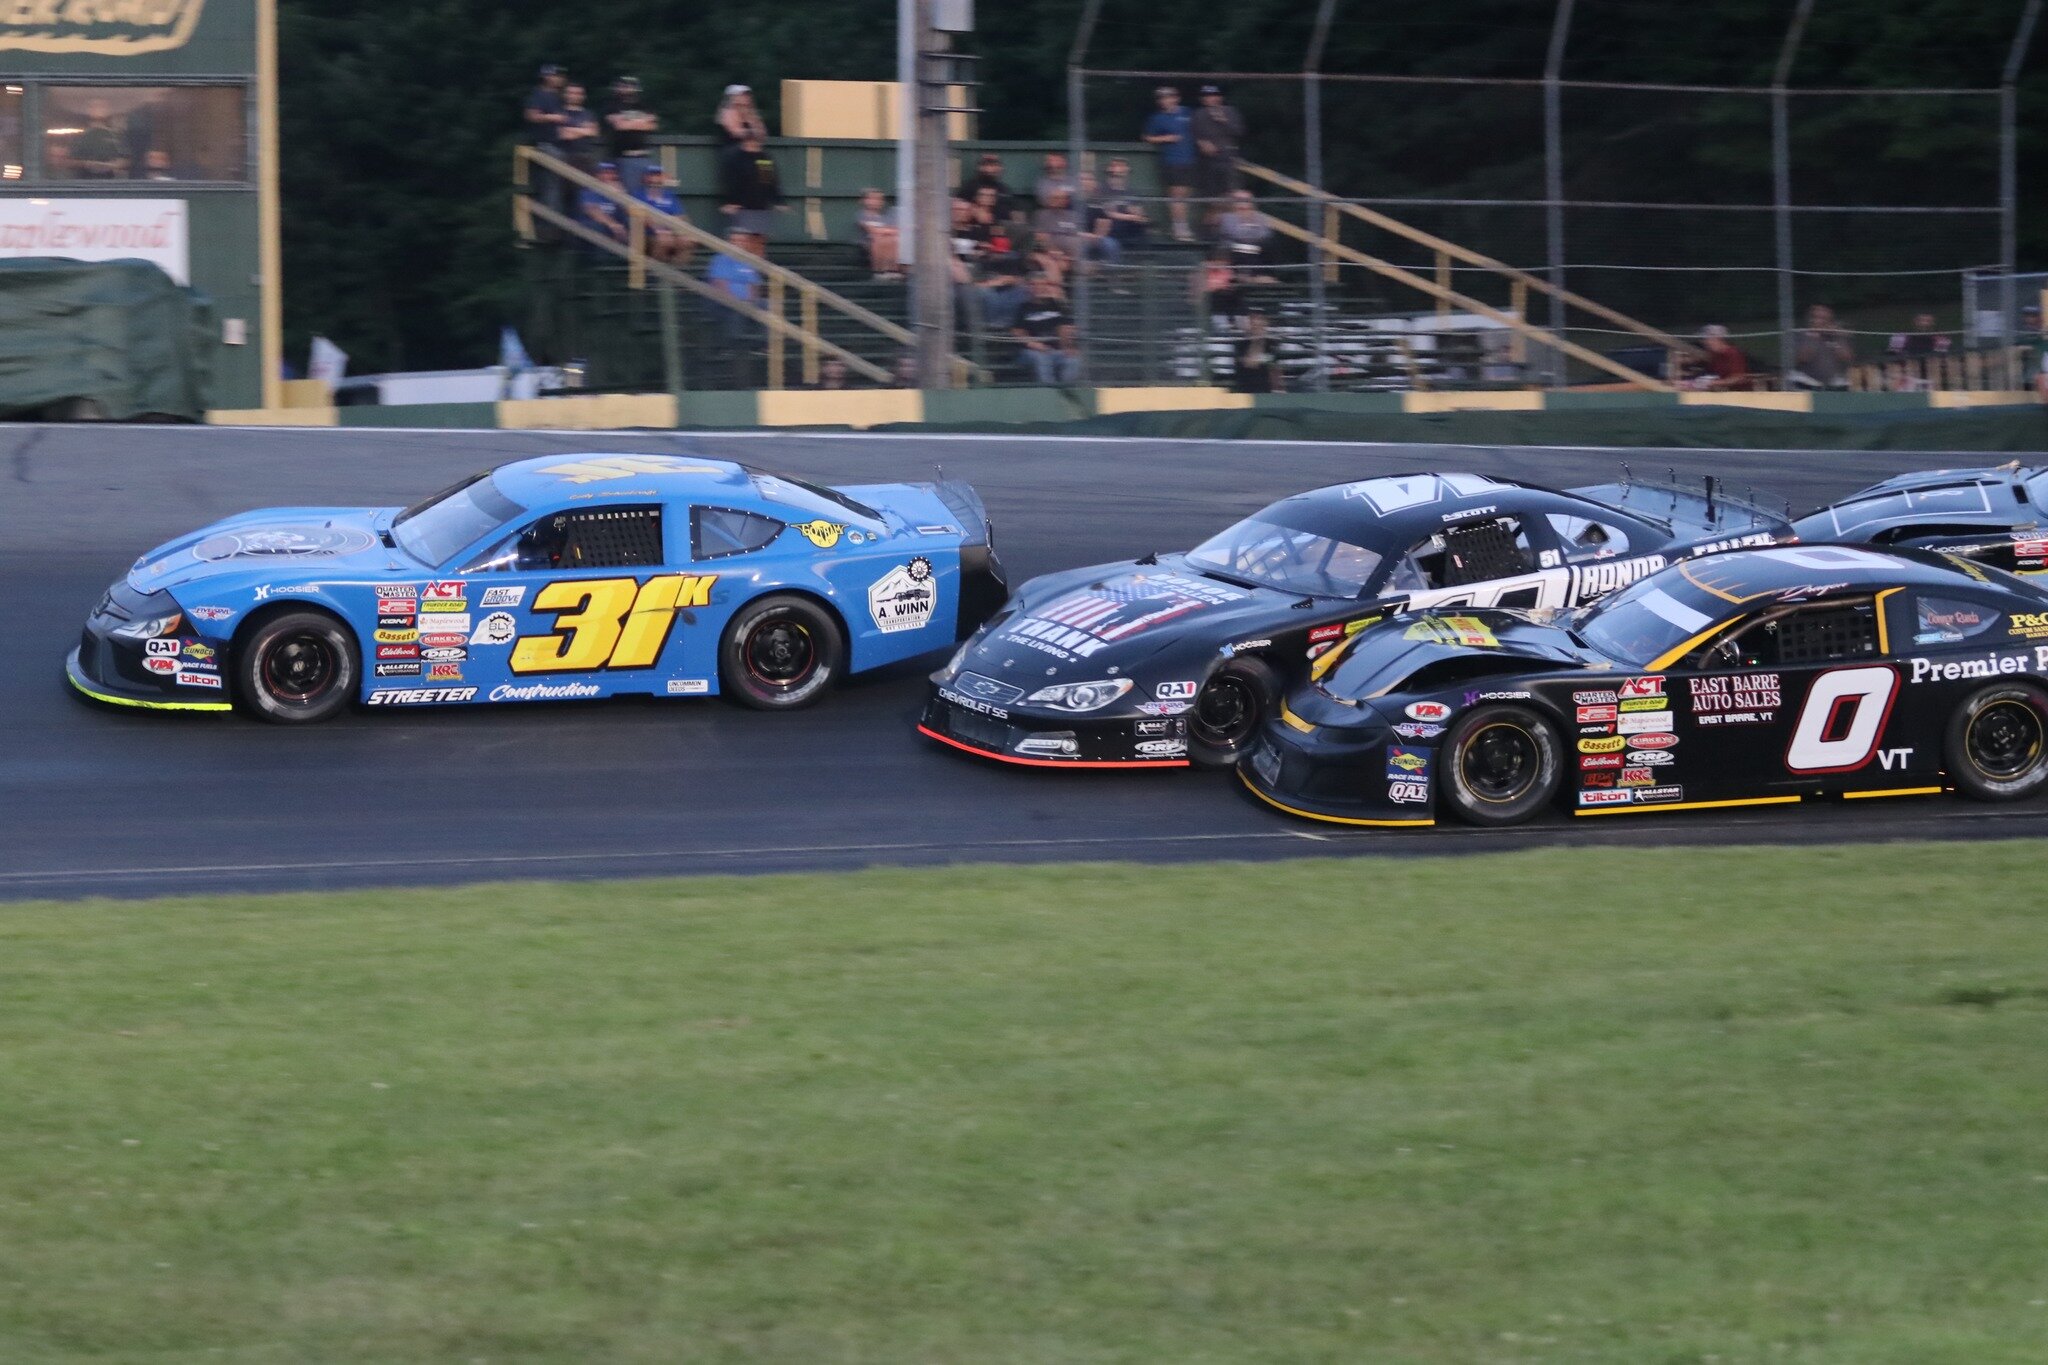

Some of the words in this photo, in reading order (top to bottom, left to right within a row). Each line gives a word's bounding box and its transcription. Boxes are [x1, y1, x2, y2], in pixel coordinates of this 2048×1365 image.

[1539, 551, 1561, 568] 51
[270, 585, 320, 594] HOOSIER
[878, 607, 891, 619] A.
[895, 600, 929, 616] WINN
[379, 617, 407, 625] KONI
[379, 631, 416, 640] Bassett
[1009, 618, 1109, 658] THANK
[149, 642, 177, 653] QA1
[184, 647, 214, 656] SUNOCO
[380, 648, 415, 656] Edelbrock
[1006, 634, 1028, 645] THE
[1028, 639, 1070, 658] LIVING
[432, 665, 458, 676] KRC
[1910, 653, 2028, 684] Premier
[180, 674, 219, 685] tilton
[1689, 677, 1728, 694] EAST
[1732, 674, 1780, 691] BARRE
[489, 683, 600, 701] Construction
[1158, 683, 1194, 696] QA1
[368, 688, 478, 705] STREETER
[1692, 694, 1732, 711] AUTO
[1735, 691, 1781, 708] SALES
[939, 688, 992, 714] CHEVROLET
[993, 709, 1008, 719] SS
[1699, 715, 1722, 724] EAST
[1760, 712, 1773, 720] VT
[1784, 664, 1900, 774] 0
[1583, 740, 1620, 749] Bassett
[1583, 757, 1620, 766] Edelbrock
[1877, 748, 1913, 771] VT
[1624, 769, 1650, 782] KRC
[1389, 783, 1427, 803] QA1
[1583, 793, 1627, 802] tilton
